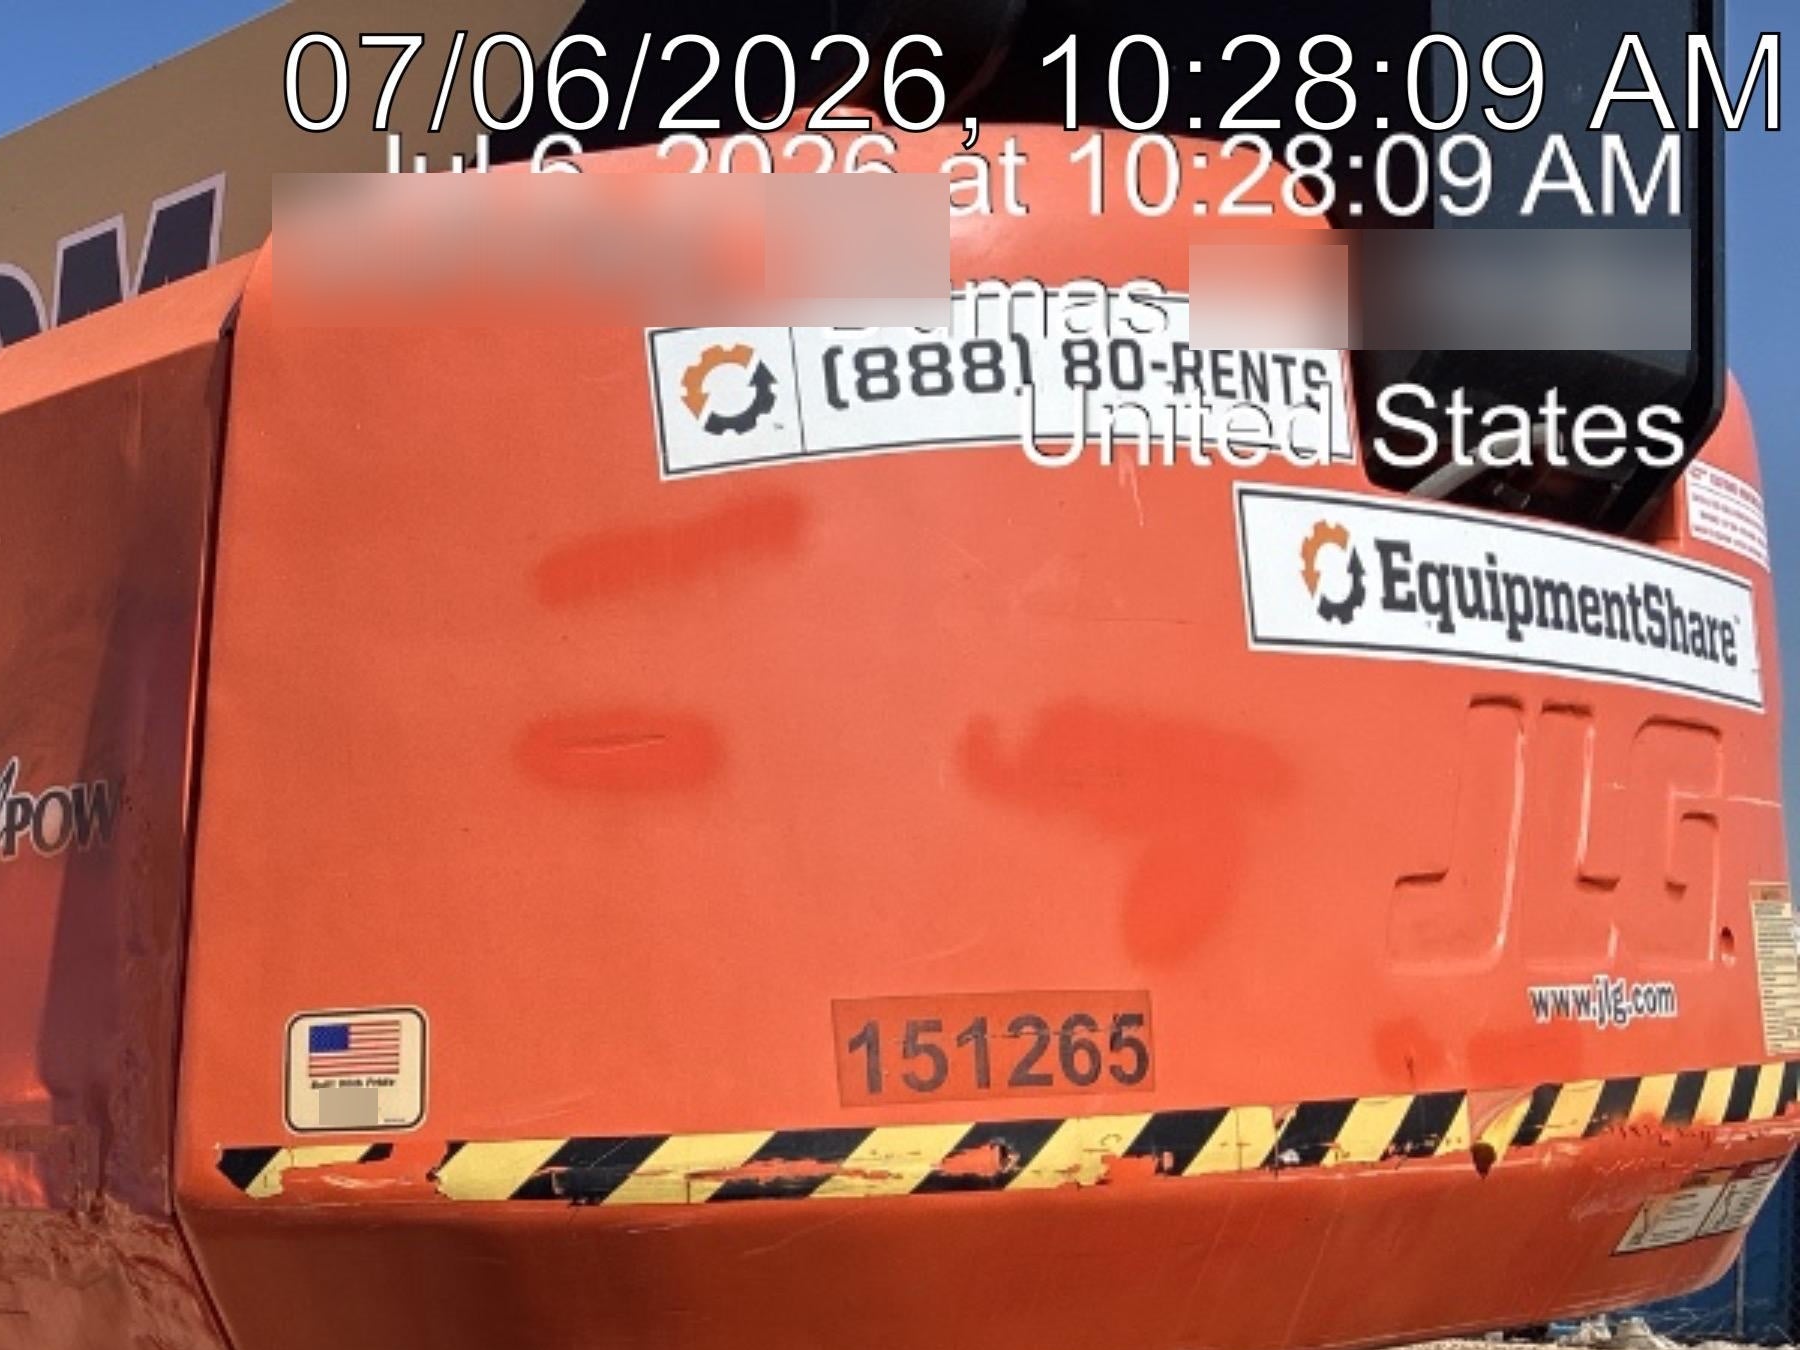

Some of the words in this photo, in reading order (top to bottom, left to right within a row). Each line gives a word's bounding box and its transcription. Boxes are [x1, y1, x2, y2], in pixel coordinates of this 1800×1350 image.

[1373, 538, 1738, 668] EquipmentShare
[1529, 975, 1678, 1029] www.jlg.com
[848, 1013, 1149, 1095] 151265
